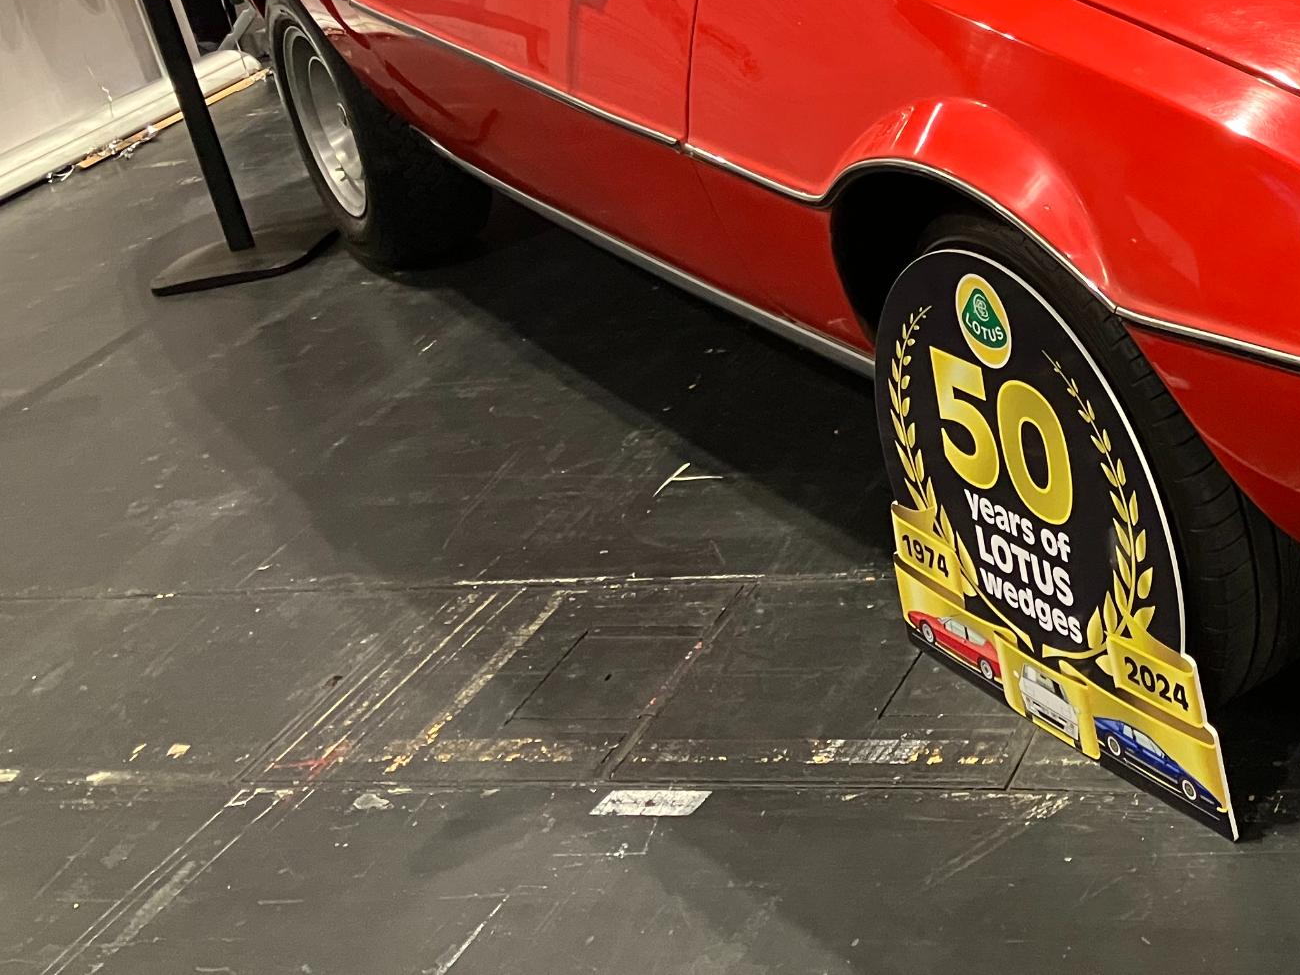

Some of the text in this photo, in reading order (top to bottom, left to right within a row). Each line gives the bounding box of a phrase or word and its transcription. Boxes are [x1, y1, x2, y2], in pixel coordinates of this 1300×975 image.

[965, 312, 1004, 342] LOTUS
[929, 345, 1073, 525] 50
[901, 534, 949, 578] 1974
[964, 489, 1071, 563] years of
[975, 526, 1074, 606] LOTUS
[979, 568, 1083, 644] wedges
[1123, 656, 1190, 712] 2024
